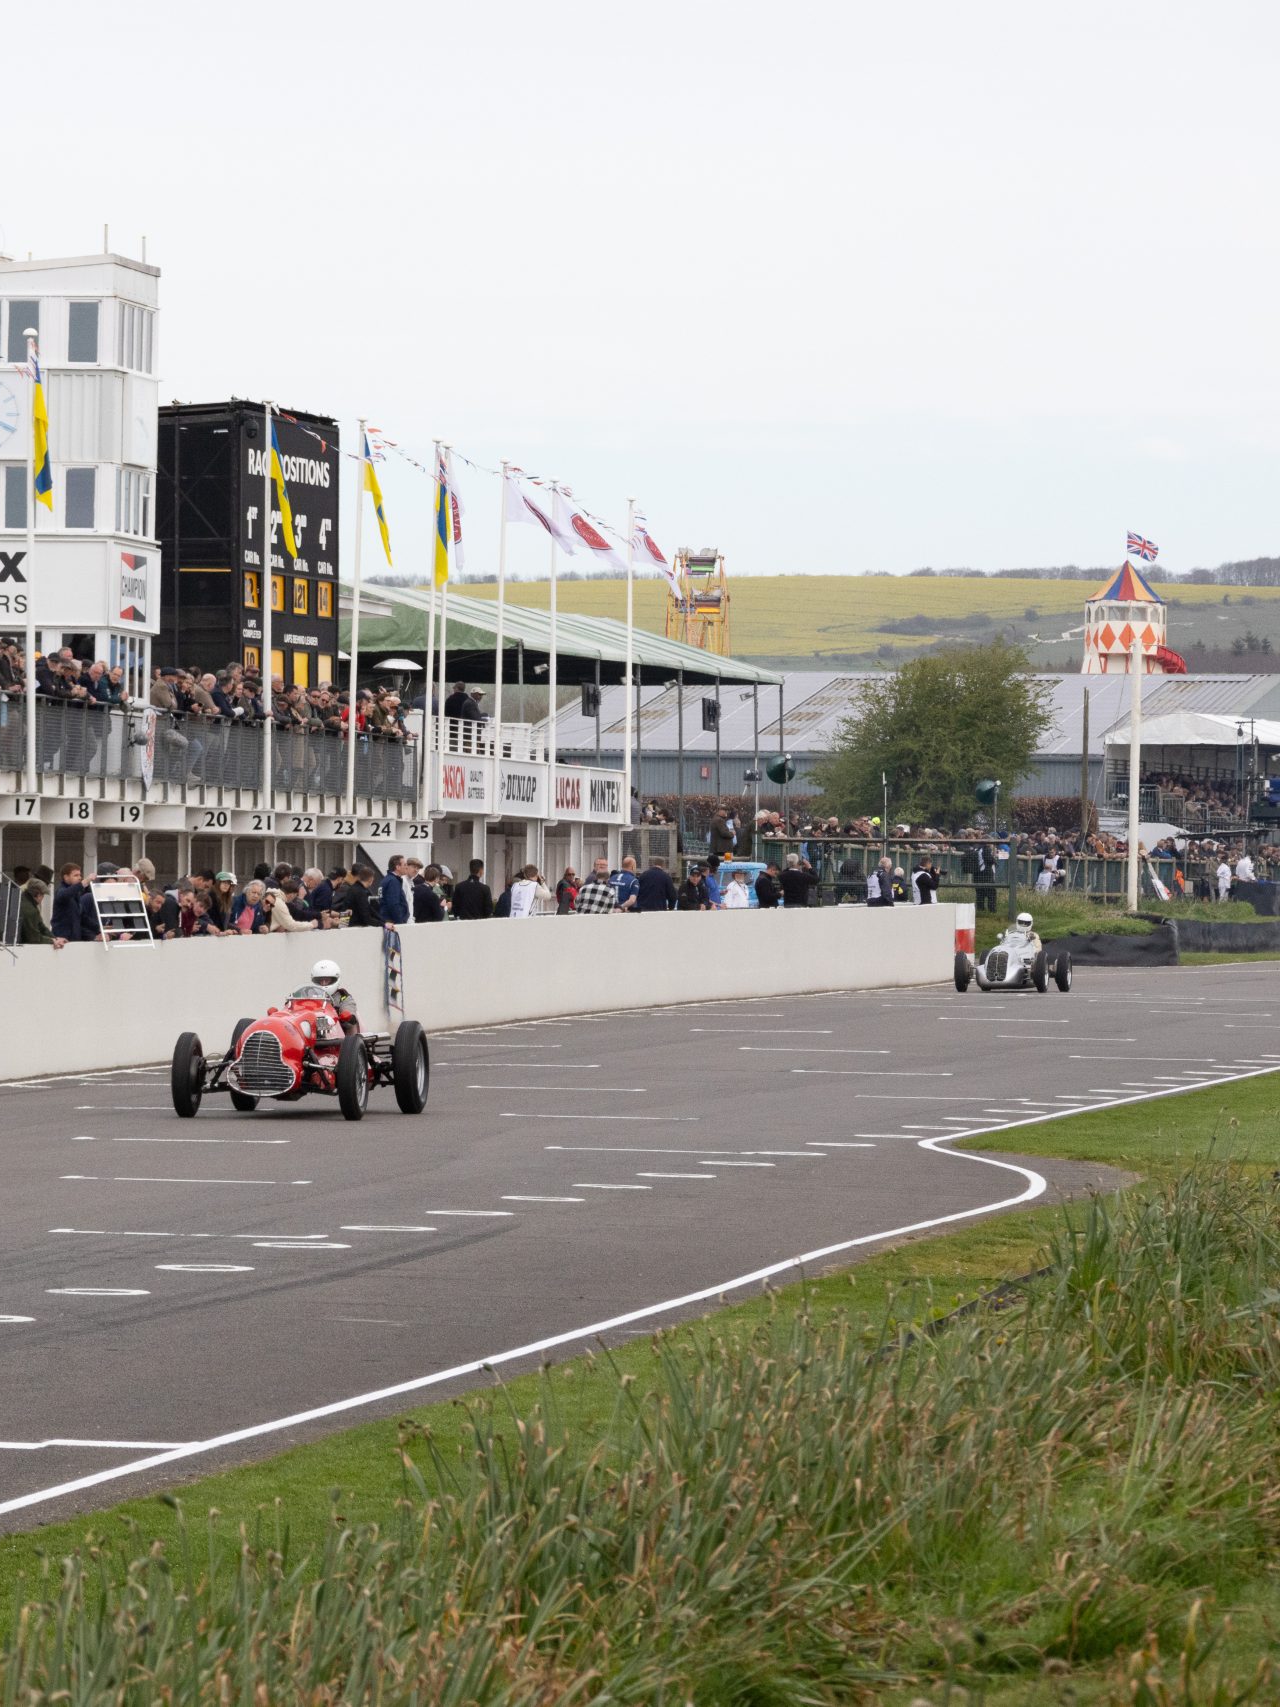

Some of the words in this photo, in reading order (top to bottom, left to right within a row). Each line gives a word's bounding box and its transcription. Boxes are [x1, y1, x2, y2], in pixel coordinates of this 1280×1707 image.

[248, 448, 267, 477] RAC
[121, 575, 146, 600] CHAMPION
[470, 770, 483, 783] QUALITY
[468, 787, 485, 800] BATTERIES
[505, 774, 537, 803] DUNLOP
[555, 777, 580, 810] LUCAS
[589, 779, 622, 813] MINTEX
[15, 798, 36, 816] 17
[69, 802, 90, 820] 18
[120, 805, 140, 823] 19
[204, 810, 228, 828] 20
[251, 814, 272, 832] 21
[291, 816, 314, 833] 22
[333, 819, 355, 835] 23
[370, 821, 392, 837] 24
[409, 824, 429, 840] 25
